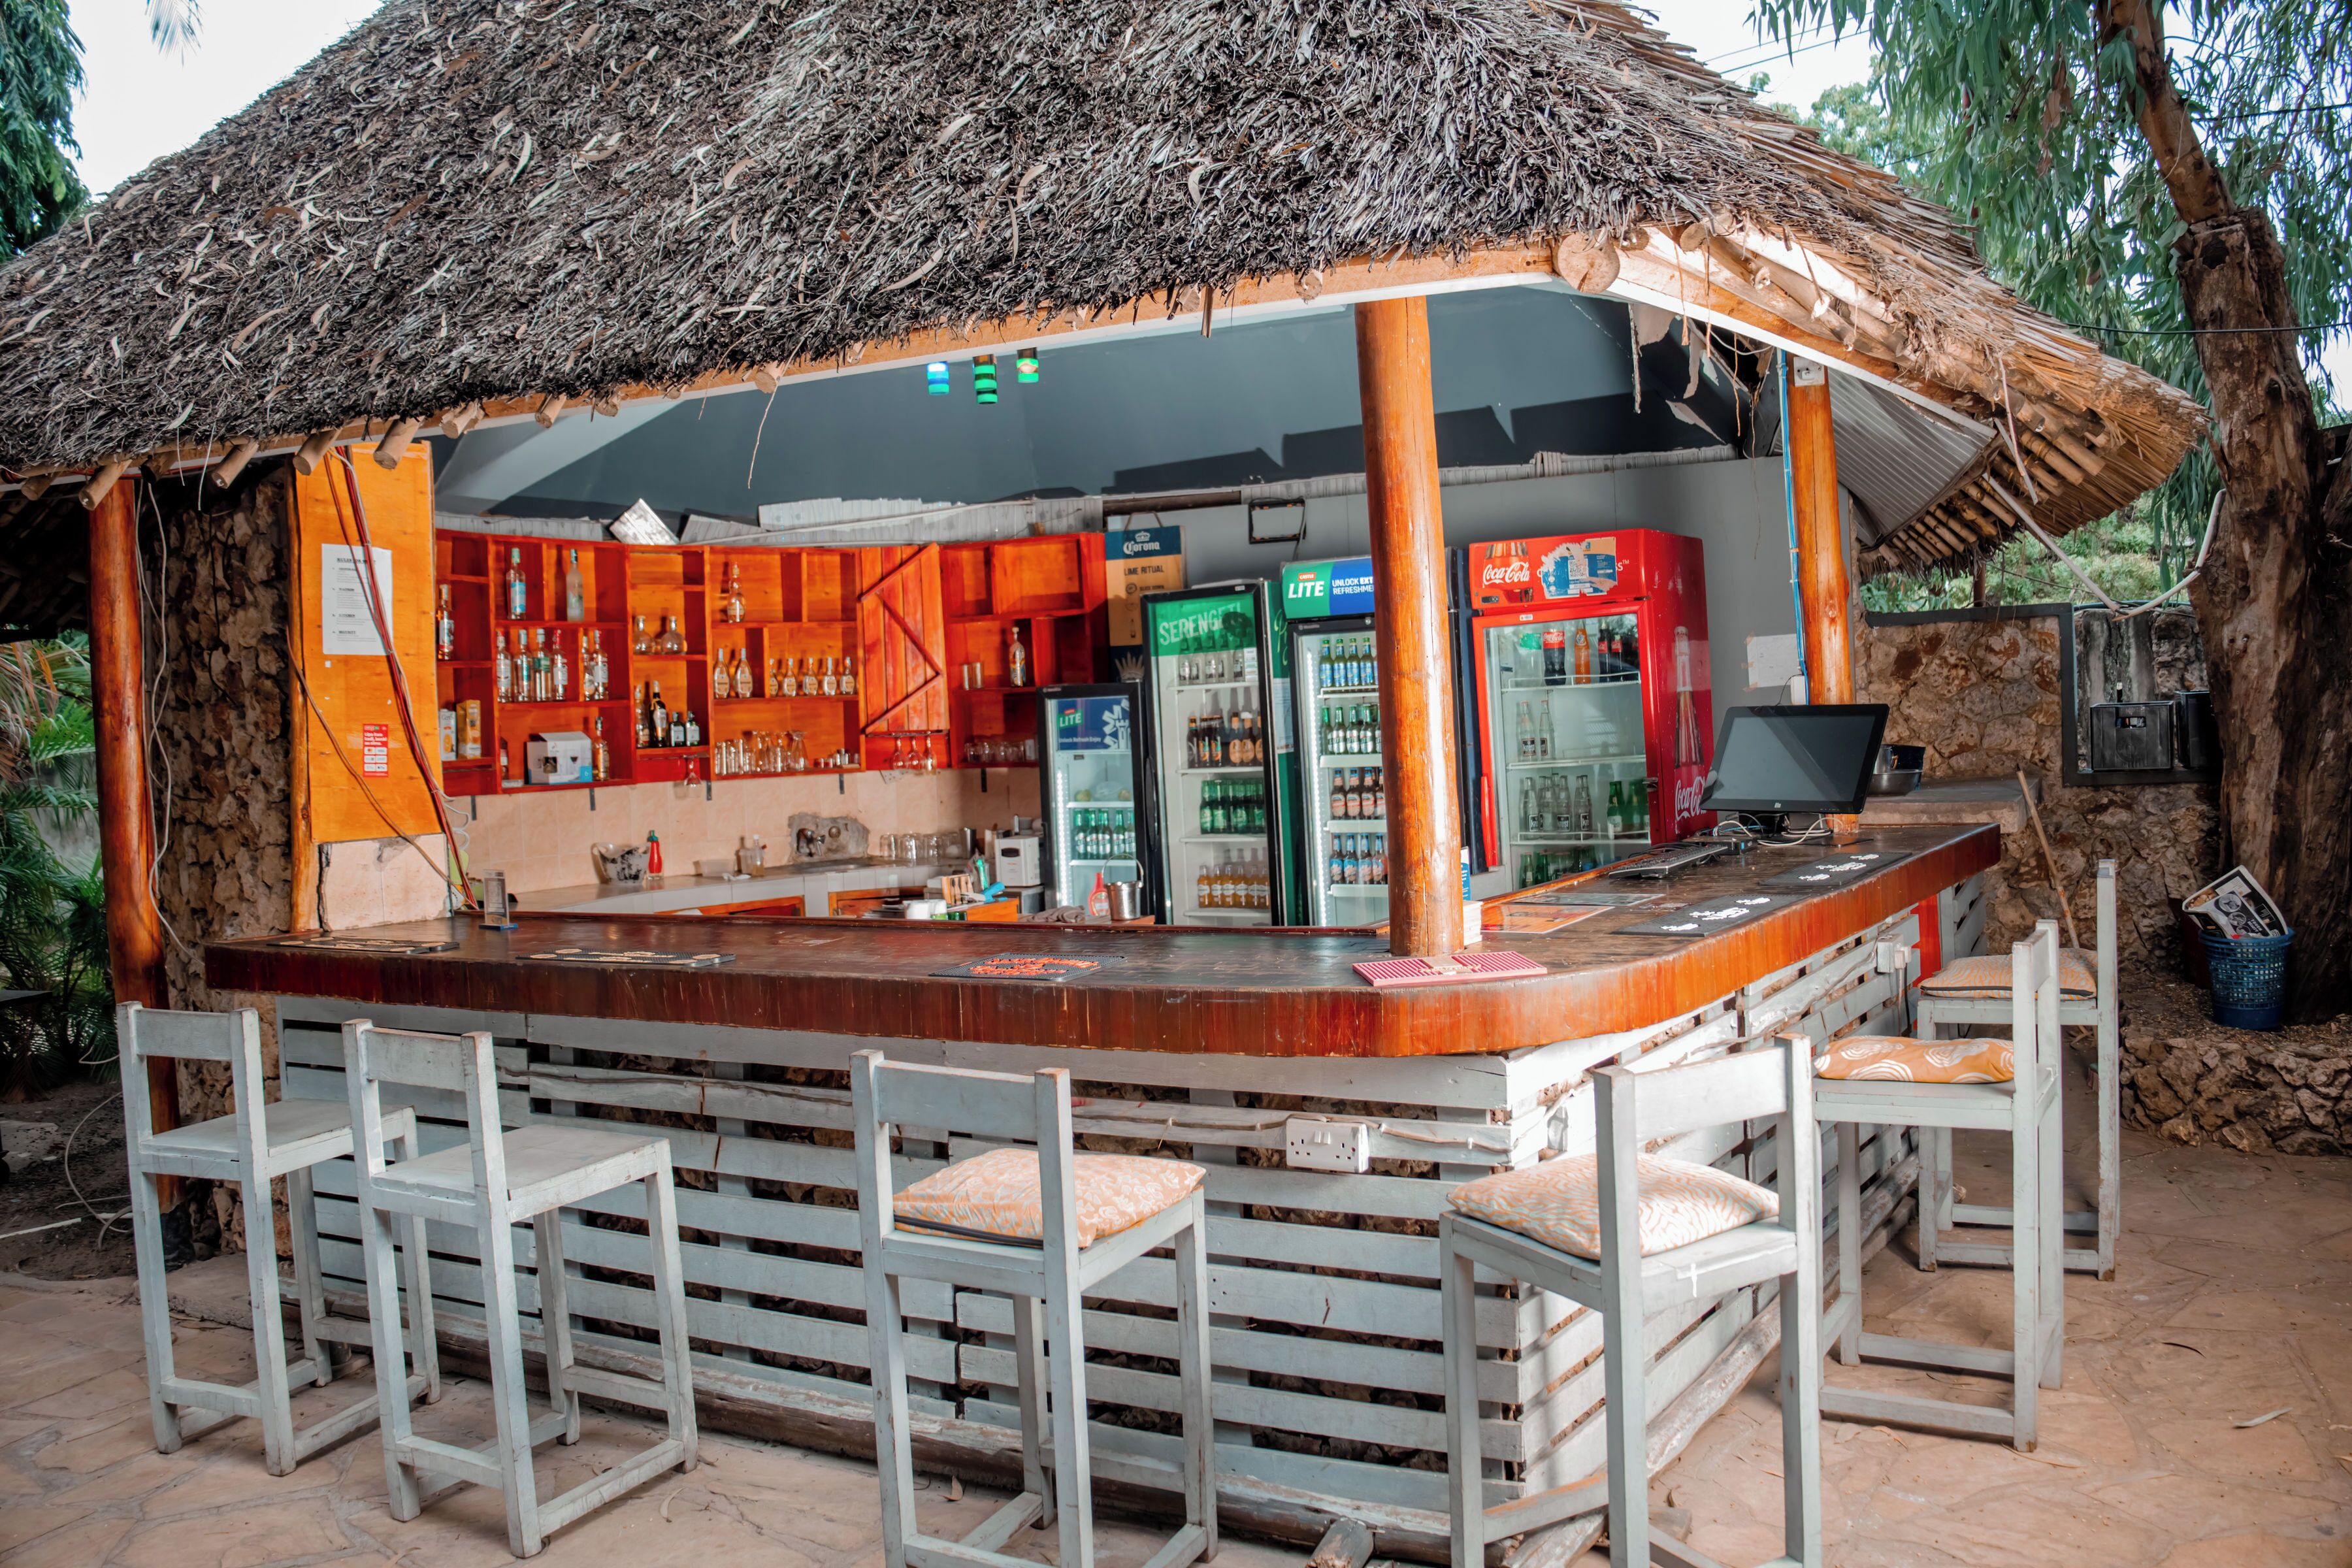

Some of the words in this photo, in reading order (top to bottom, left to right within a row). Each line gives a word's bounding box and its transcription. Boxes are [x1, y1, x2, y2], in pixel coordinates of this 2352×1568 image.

[1123, 541, 1160, 555] Corona
[1124, 567, 1139, 576] LIME
[1141, 565, 1165, 575] RITUAL
[1483, 562, 1530, 585] Coca-Cola
[1332, 578, 1359, 587] UNLOCK
[1360, 576, 1373, 585] EXT
[1288, 581, 1325, 598] LITE
[1333, 585, 1374, 595] REFRESHME
[1060, 713, 1081, 727] LITE
